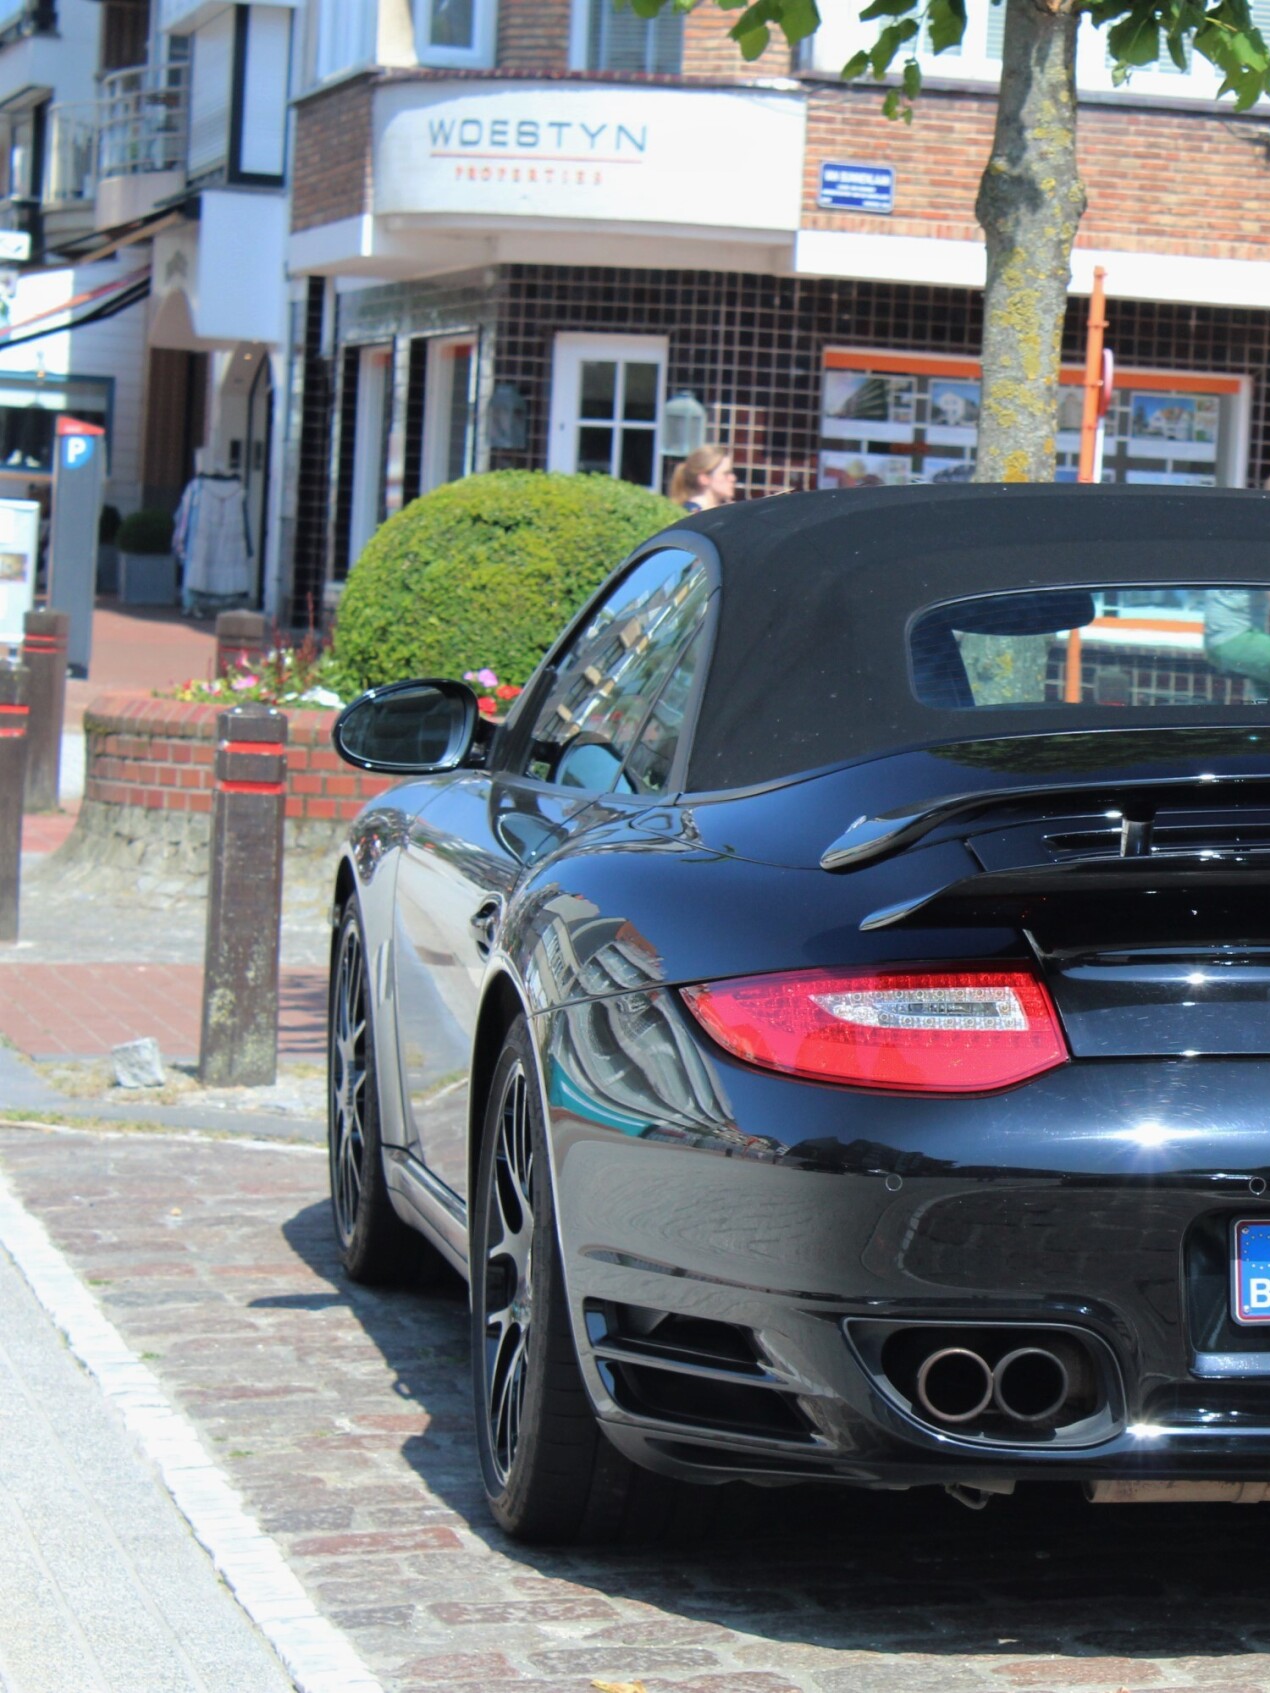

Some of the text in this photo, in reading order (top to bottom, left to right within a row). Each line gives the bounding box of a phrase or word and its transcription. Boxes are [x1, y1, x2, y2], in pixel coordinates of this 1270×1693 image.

[429, 118, 647, 152] WOESTYN
[455, 164, 602, 185] PROPERTIES
[68, 436, 87, 464] P
